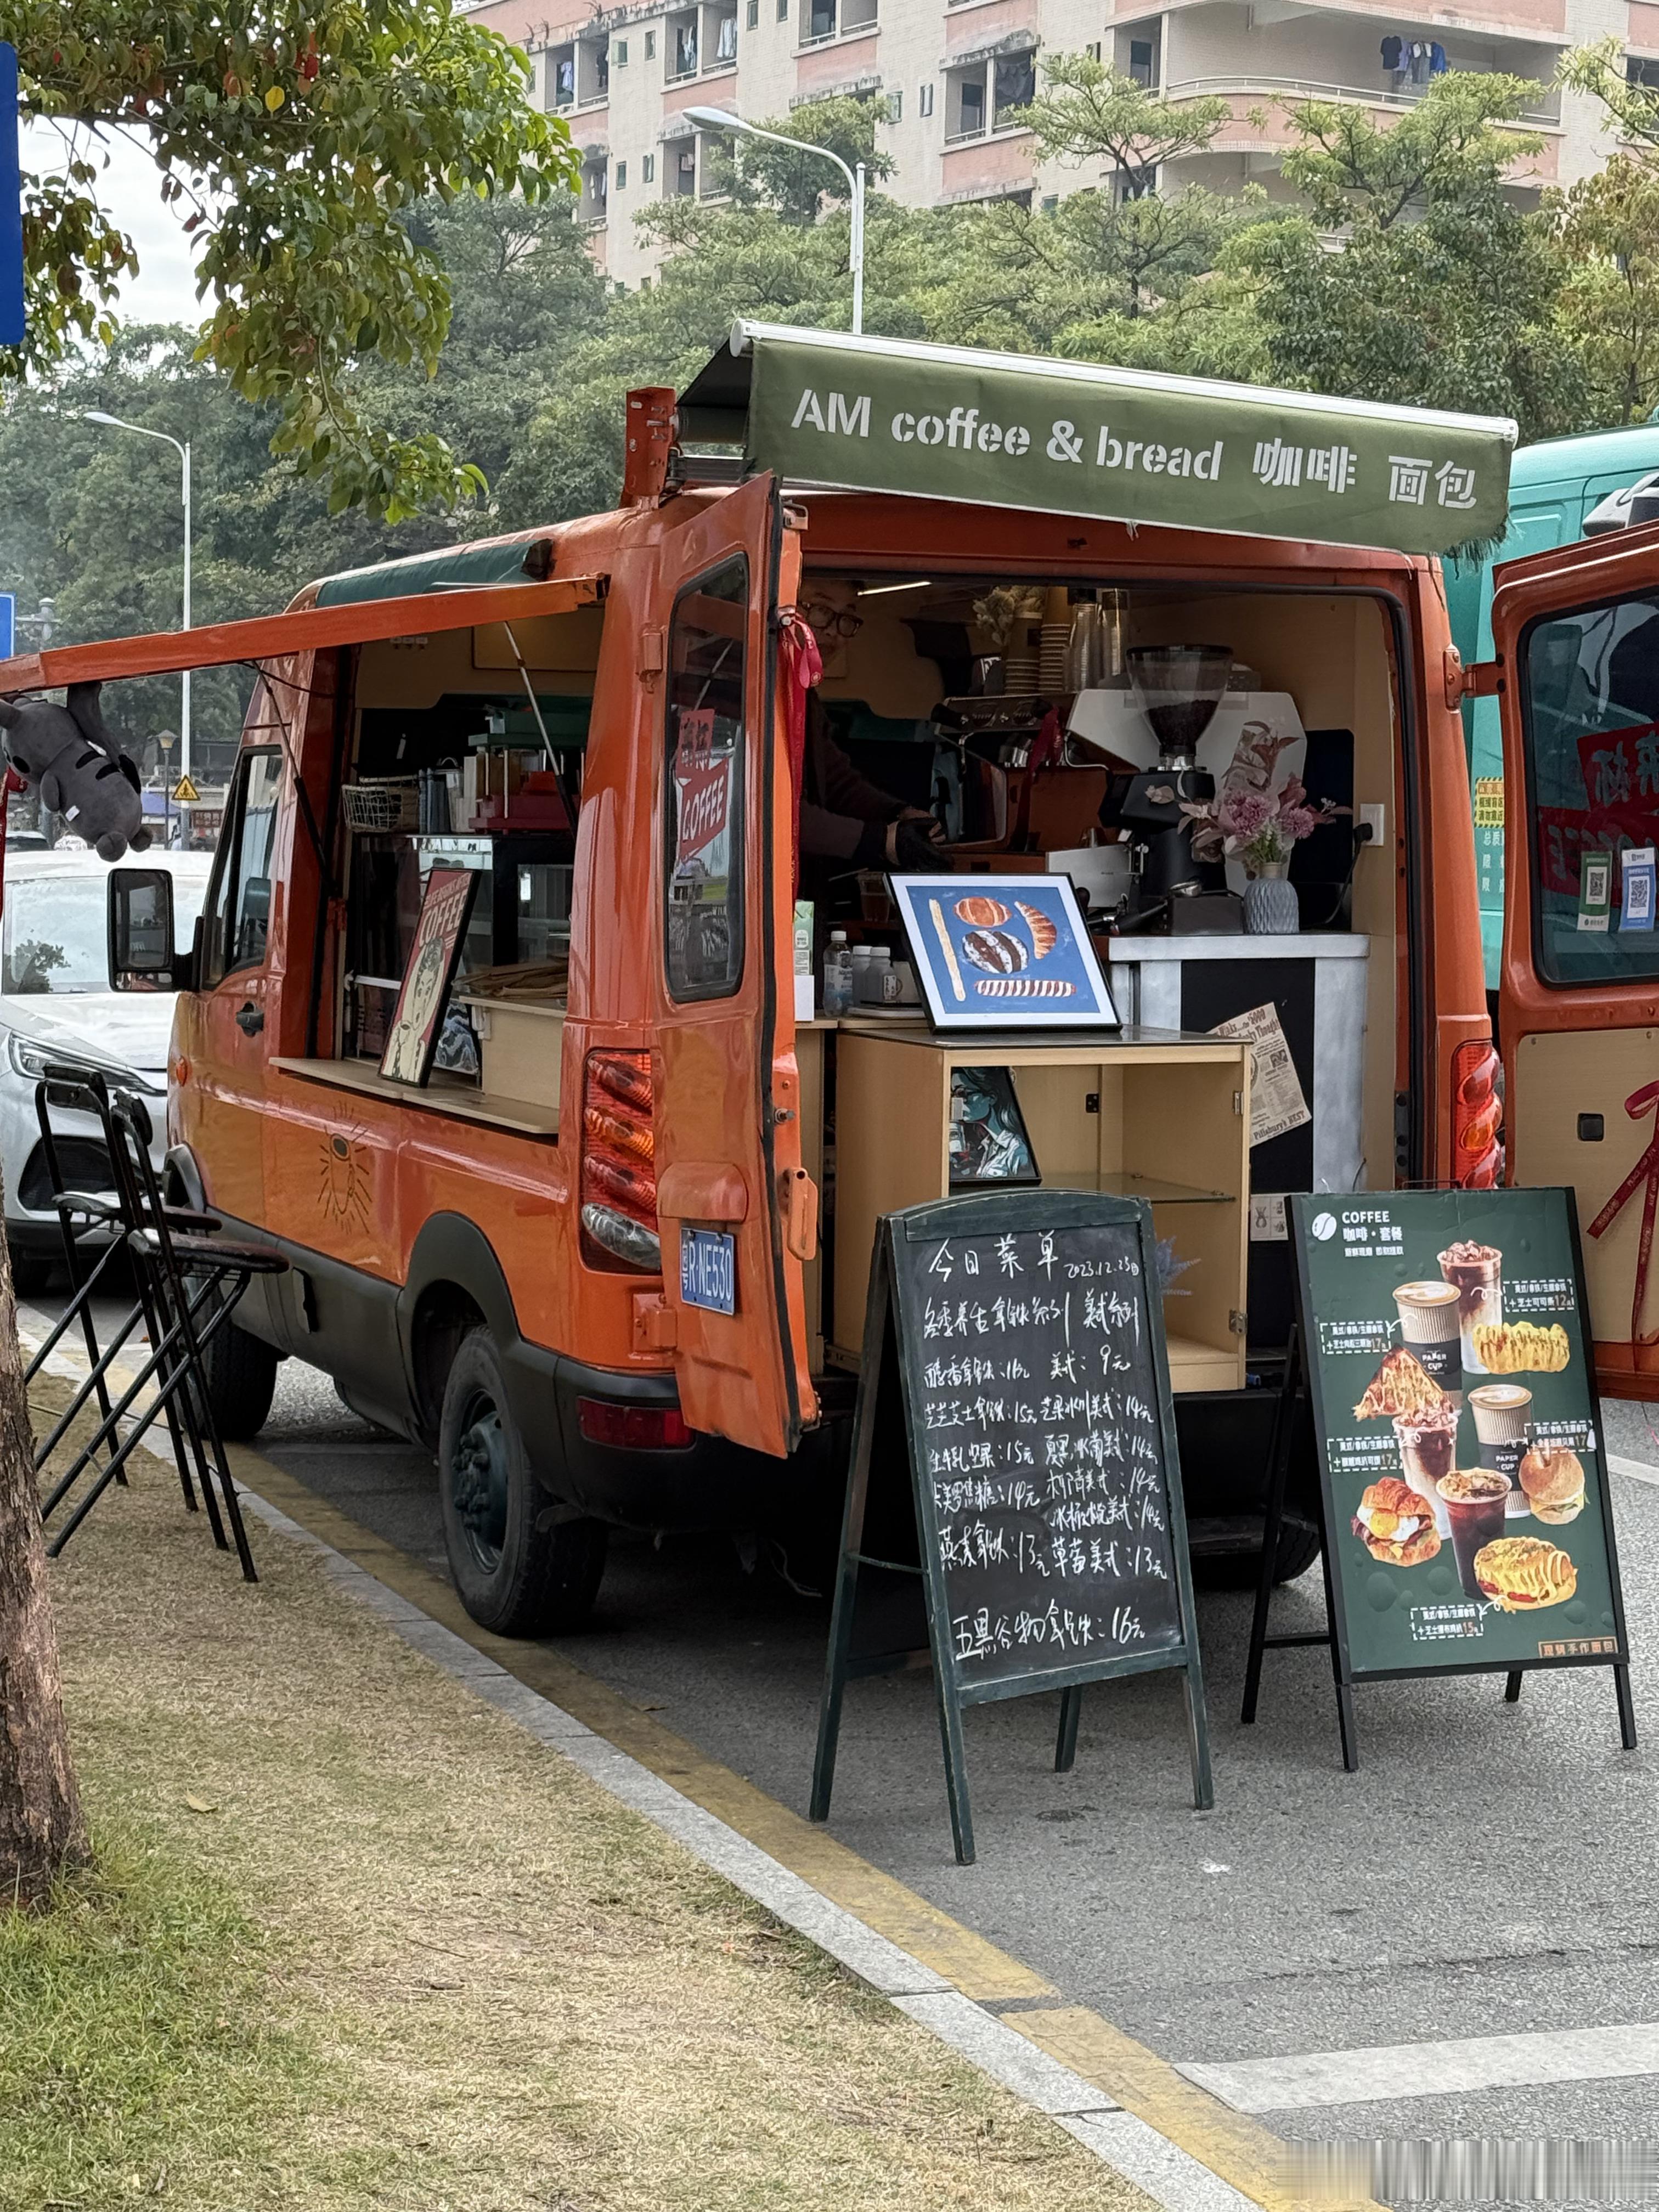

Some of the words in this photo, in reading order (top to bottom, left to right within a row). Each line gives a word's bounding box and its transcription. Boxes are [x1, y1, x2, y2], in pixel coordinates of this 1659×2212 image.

[792, 388, 871, 438] AM
[891, 407, 1030, 456] coffee
[1046, 419, 1084, 464] &
[1097, 426, 1223, 481] bread
[1253, 437, 1358, 494] 咖啡
[1388, 455, 1477, 509] 面包
[682, 775, 725, 841] COFFEE
[1483, 830, 1504, 847] 总质
[419, 889, 468, 947] COFFEE
[1342, 1211, 1390, 1224] COFFEE
[928, 1229, 1060, 1283] 今日菜单
